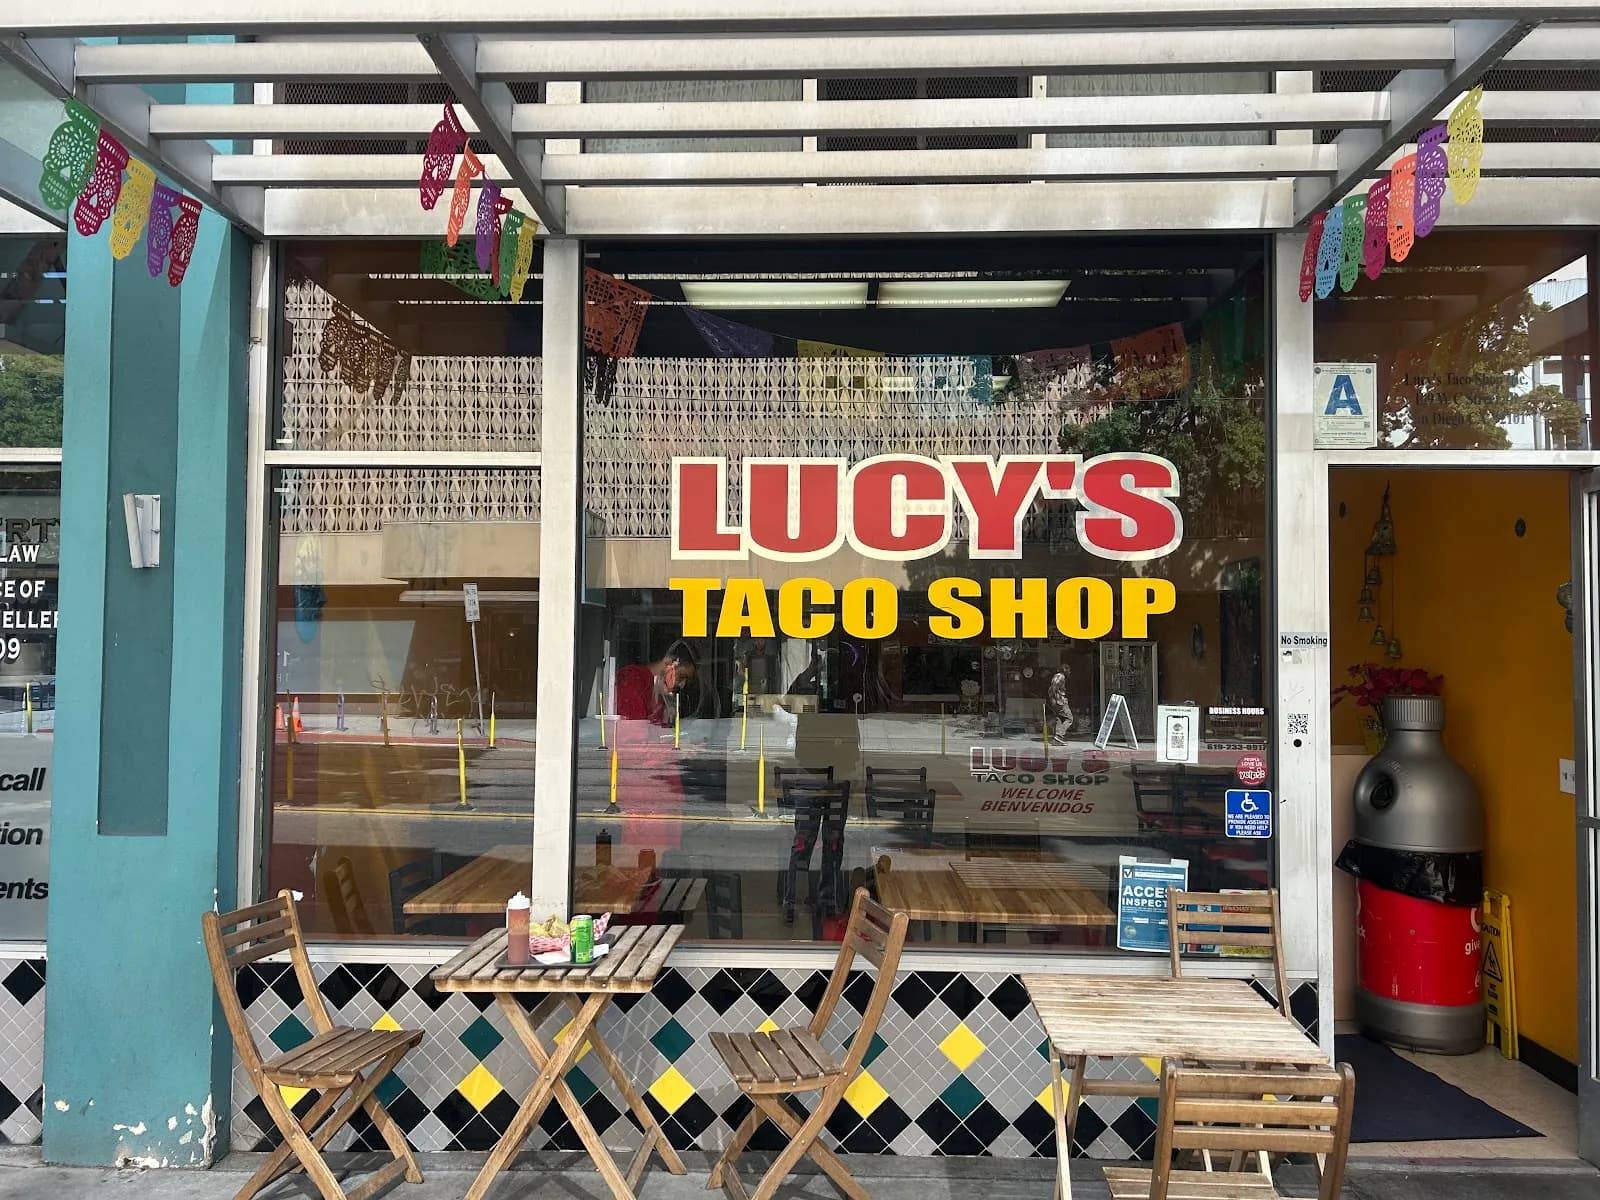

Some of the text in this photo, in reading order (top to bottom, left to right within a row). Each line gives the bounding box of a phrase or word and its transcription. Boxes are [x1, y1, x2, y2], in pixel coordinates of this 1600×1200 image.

[1324, 374, 1363, 415] A
[671, 451, 1183, 562] LUCY'S
[19, 579, 46, 599] OF
[669, 577, 1177, 639] TACO SHOP
[1281, 635, 1328, 648] No Smoking
[972, 772, 1110, 786] TACO SHOP
[1001, 787, 1086, 801] WELCOME
[980, 800, 1095, 815] BIENVENIDOS
